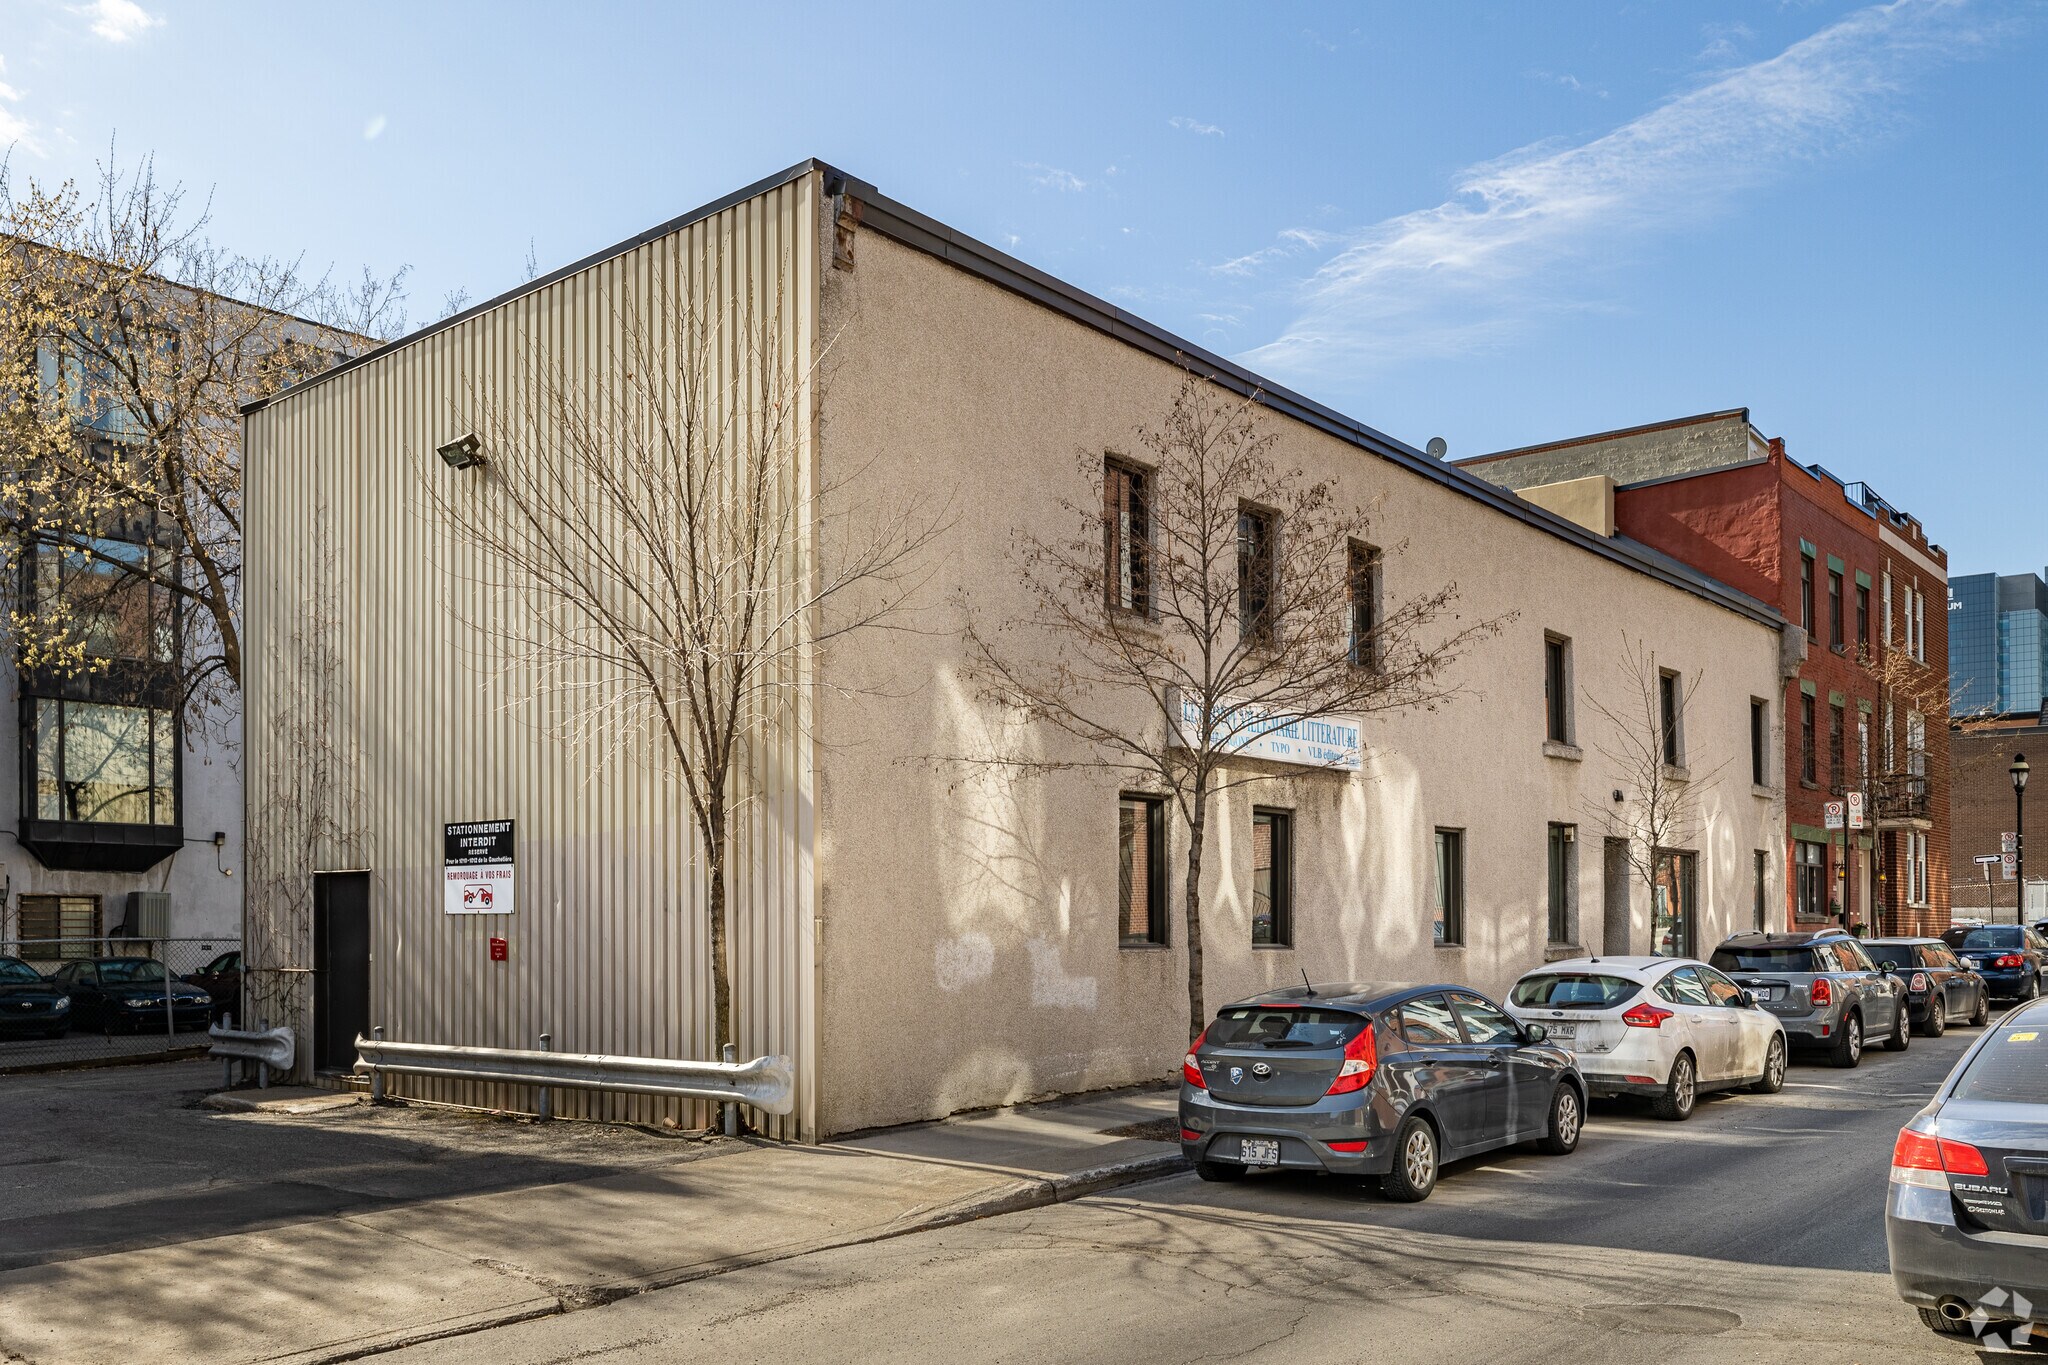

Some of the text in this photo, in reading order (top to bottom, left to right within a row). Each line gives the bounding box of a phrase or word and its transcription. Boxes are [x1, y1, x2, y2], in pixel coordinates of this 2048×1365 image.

[1271, 741, 1290, 754] TYPO
[1308, 745, 1322, 758] VLB
[447, 822, 511, 836] STATIONNEMENT
[460, 836, 497, 848] INTERDIT
[447, 871, 478, 881] REMORQUAGE
[485, 870, 495, 879] VOS
[496, 869, 512, 879] FRAIS
[1561, 1026, 1575, 1035] MXR
[1241, 1146, 1278, 1160] 615 JFS
[1954, 1183, 2008, 1194] SUBARU
